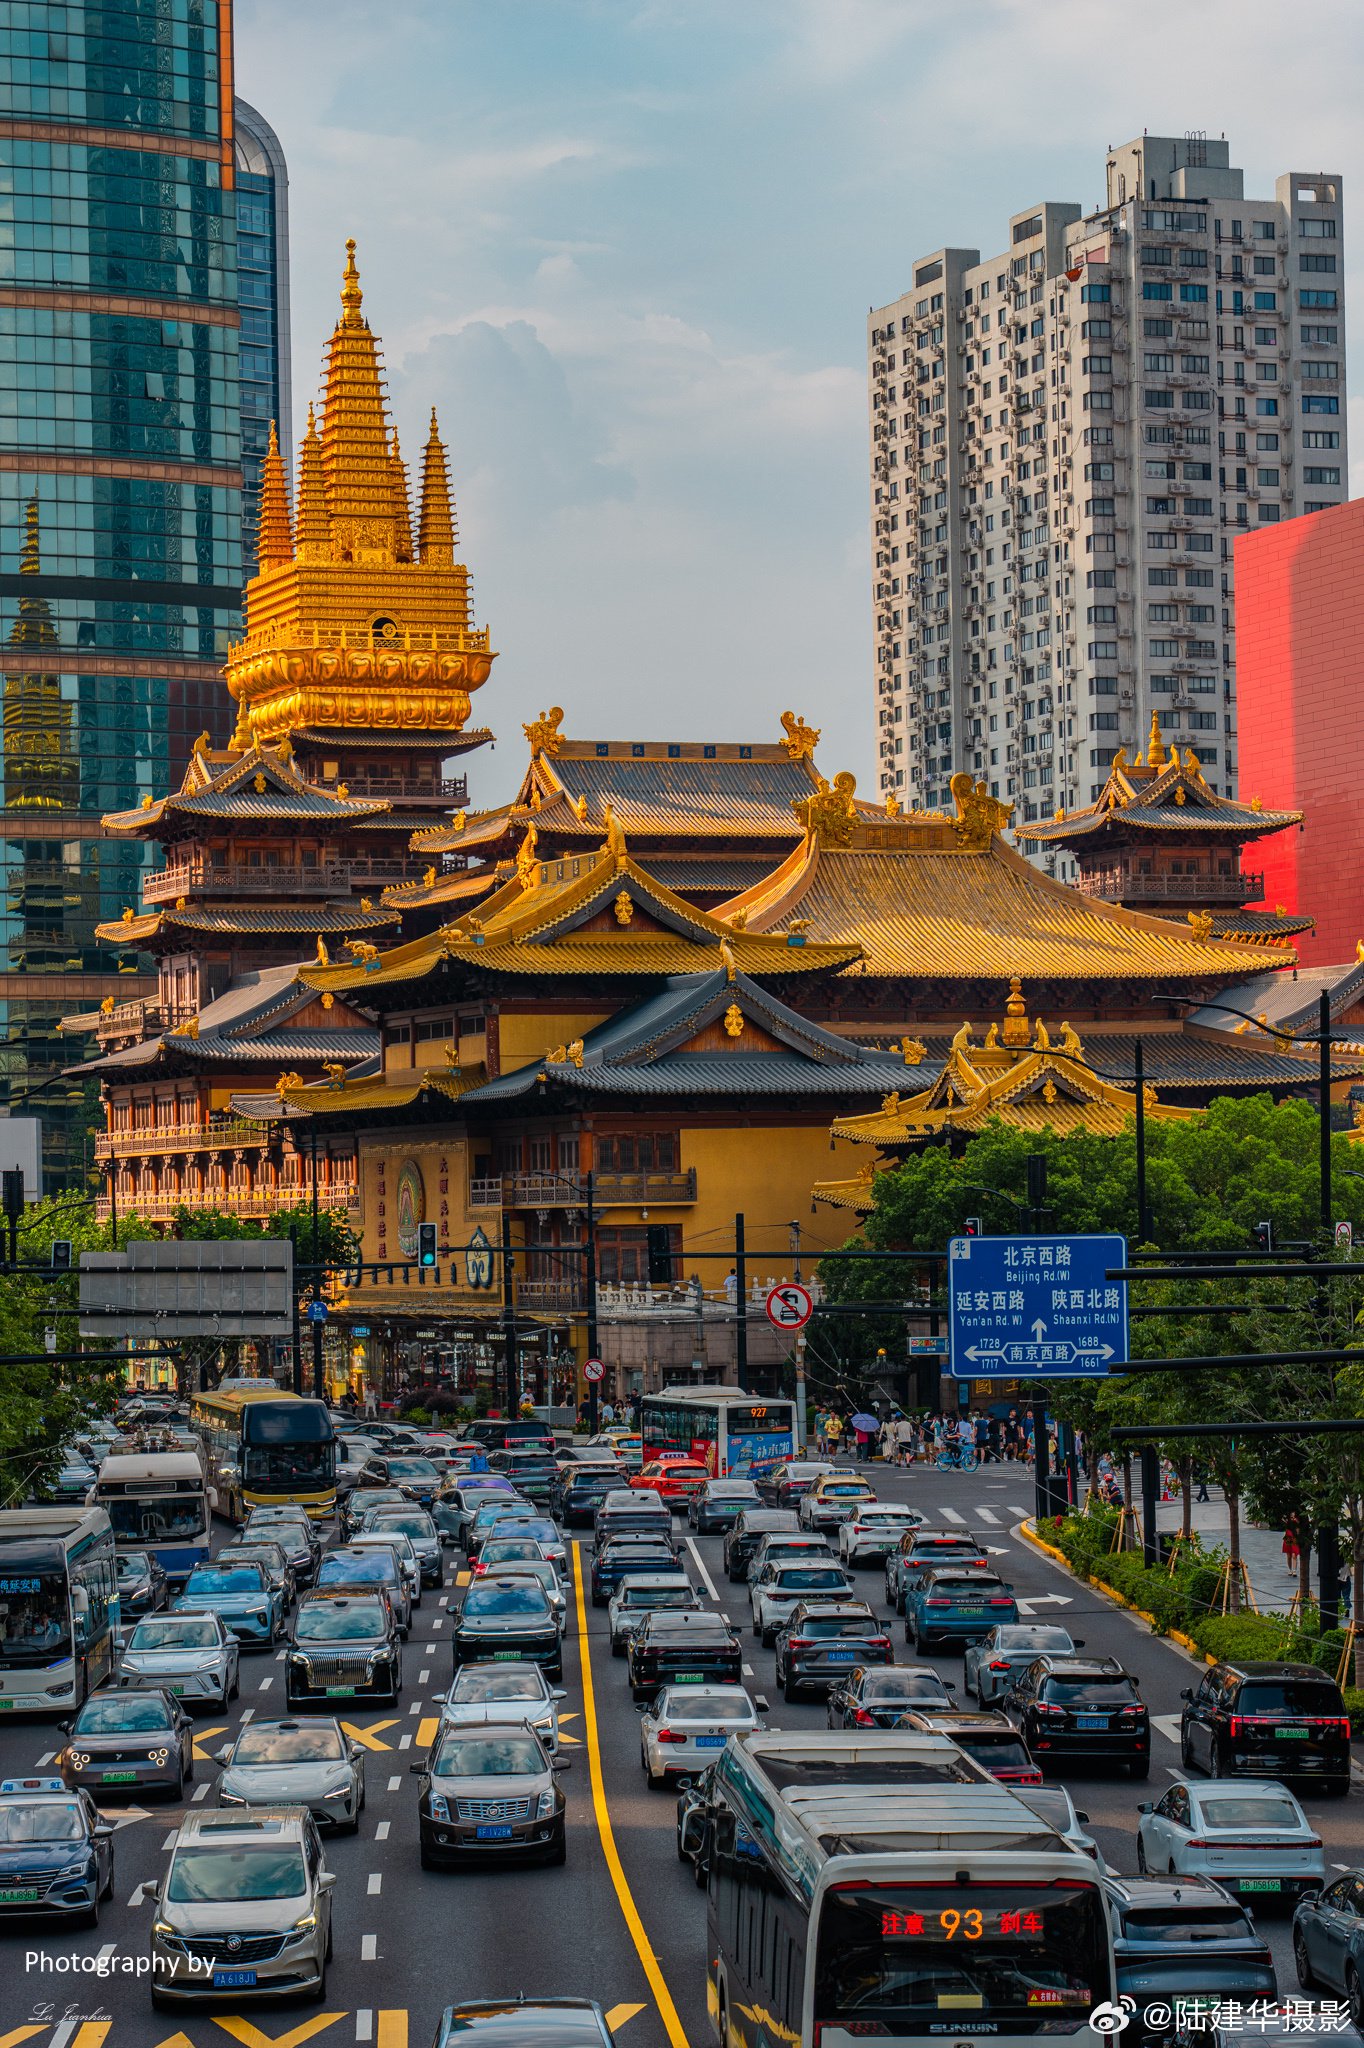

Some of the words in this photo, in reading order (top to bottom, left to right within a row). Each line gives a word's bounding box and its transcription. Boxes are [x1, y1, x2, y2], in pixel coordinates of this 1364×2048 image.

[955, 1241, 966, 1252] 北
[1003, 1245, 1072, 1267] 北京西路
[1006, 1271, 1040, 1284] Beijing
[1043, 1270, 1070, 1282] Rd.(W)
[956, 1289, 1025, 1312] 延安西路
[1052, 1288, 1120, 1310] 陕西北路
[960, 1316, 993, 1327] Yan'an
[1053, 1314, 1092, 1325] Shaanxi
[1094, 1313, 1120, 1325] Rd.(N)
[980, 1338, 1001, 1349] 1728
[1078, 1336, 1099, 1347] 1688
[1010, 1345, 1069, 1361] 南京西路
[981, 1359, 999, 1369] 1717
[1080, 1357, 1099, 1368] 1661
[751, 1408, 767, 1418] 927
[881, 1913, 925, 1936] 注意
[940, 1908, 983, 1940] 93
[999, 1911, 1044, 1934] 刹车
[929, 2023, 998, 2033] SUNWIN
